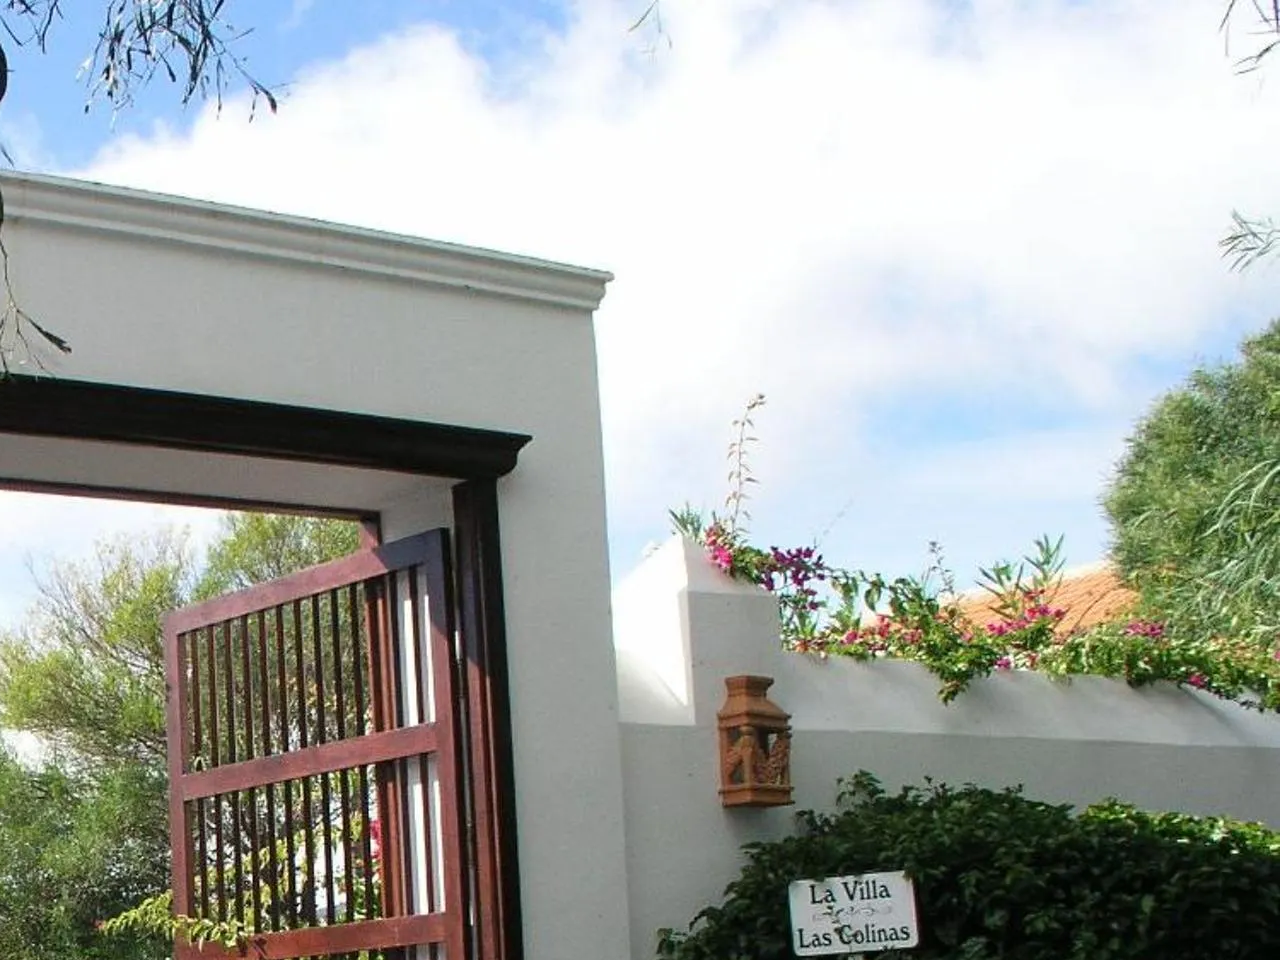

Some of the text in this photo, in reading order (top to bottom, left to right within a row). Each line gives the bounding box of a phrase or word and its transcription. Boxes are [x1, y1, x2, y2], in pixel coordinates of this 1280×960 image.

[809, 879, 891, 905] La Villa
[797, 923, 911, 949] Las Colinas
